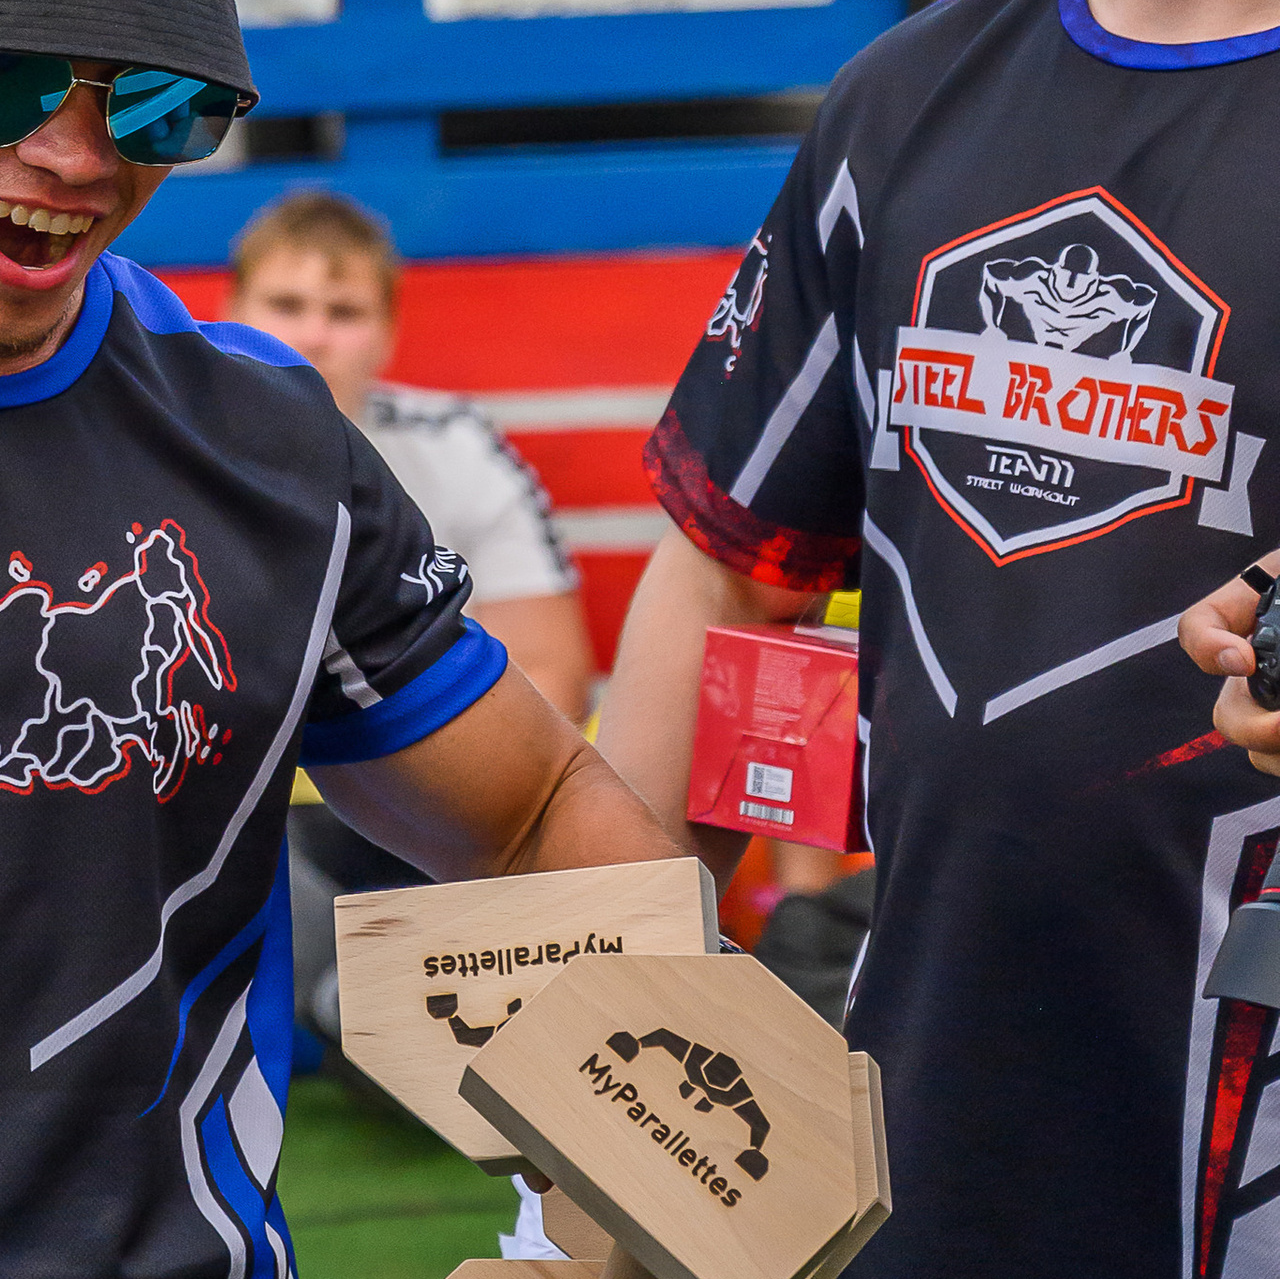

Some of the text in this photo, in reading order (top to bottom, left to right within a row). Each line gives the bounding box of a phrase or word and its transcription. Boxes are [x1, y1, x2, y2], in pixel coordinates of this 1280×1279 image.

[893, 347, 1230, 457] STEEL BROTHERS
[966, 474, 1080, 507] STREET WORKOUT
[985, 444, 1075, 488] TEAM
[578, 1052, 743, 1208] MyParallettes
